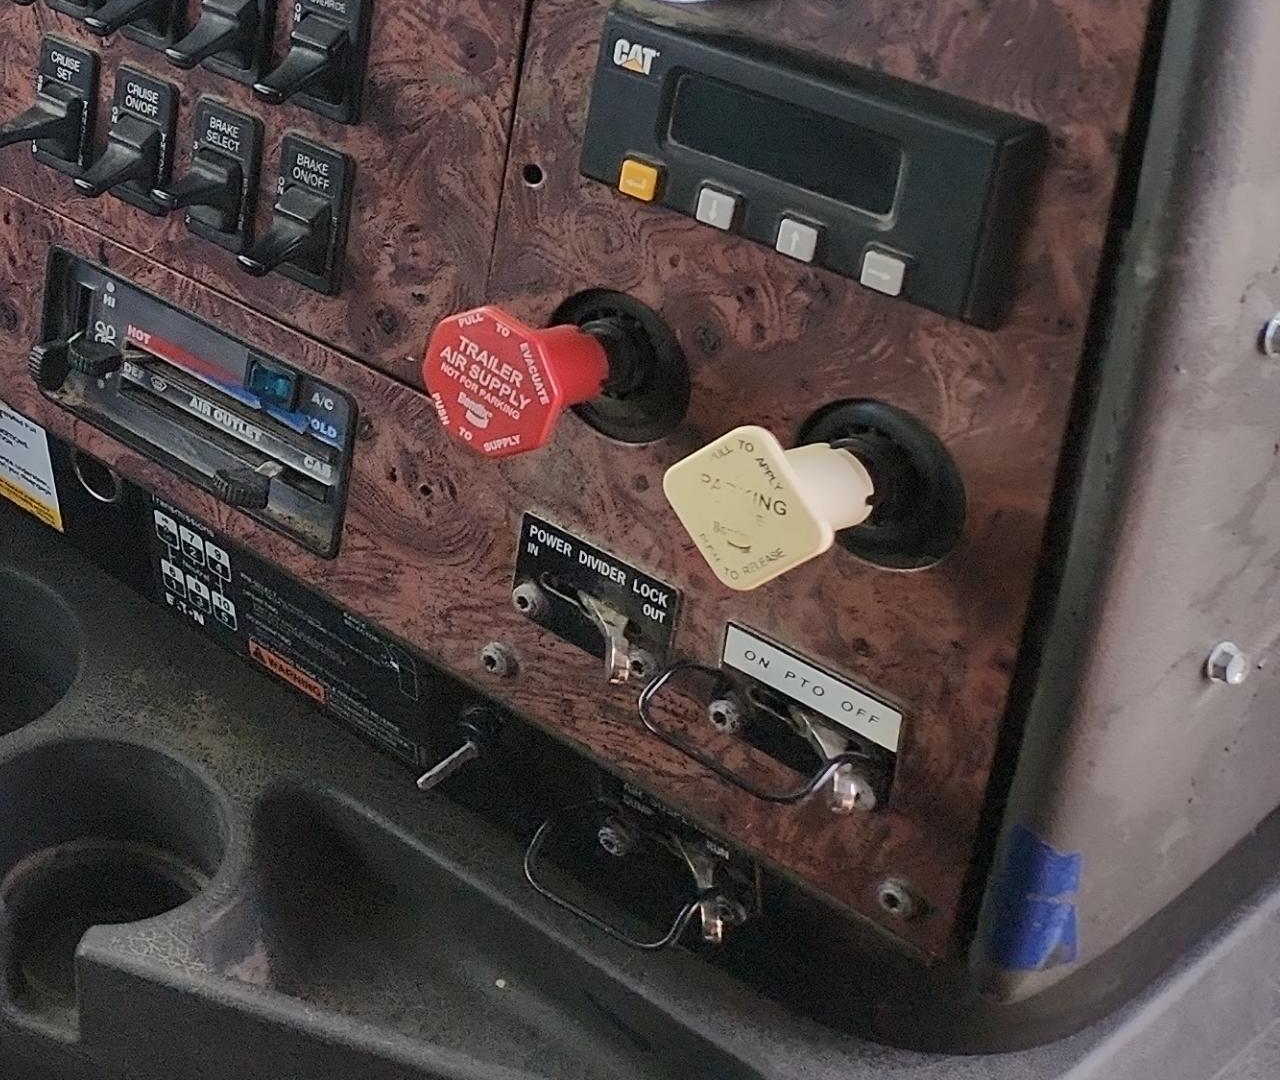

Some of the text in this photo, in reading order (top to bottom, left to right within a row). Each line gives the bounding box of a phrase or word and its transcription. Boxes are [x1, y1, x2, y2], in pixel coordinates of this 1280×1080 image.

[51, 51, 81, 73] CRUISE
[613, 38, 656, 75] CAT
[56, 67, 73, 82] SET
[126, 82, 159, 104] CRUISE
[125, 95, 159, 117] ON/OFF
[209, 116, 239, 138] BRAKE
[205, 129, 240, 152] SELECT
[296, 153, 329, 177] BRAKE
[292, 166, 330, 190] ON/OFF
[103, 293, 116, 309] HI
[127, 324, 151, 345] HOT
[458, 313, 550, 406] PULL TO EVACUATE
[458, 335, 524, 388] TRAILER
[440, 346, 531, 410] AIR SUPPLY
[311, 392, 334, 411] A/C
[440, 362, 520, 420] NOT FOR PARKING
[190, 395, 262, 443] AIR OUTLET
[306, 414, 337, 439] OLD
[432, 392, 521, 452] PUSH TO SUPPLY
[738, 439, 784, 491] TO APPLY
[527, 542, 539, 557] IN
[528, 524, 669, 609] POWER DIVIDER LOCK
[724, 567, 739, 580] TO
[642, 602, 667, 624] OUT
[744, 649, 881, 727] ON PTO OFF
